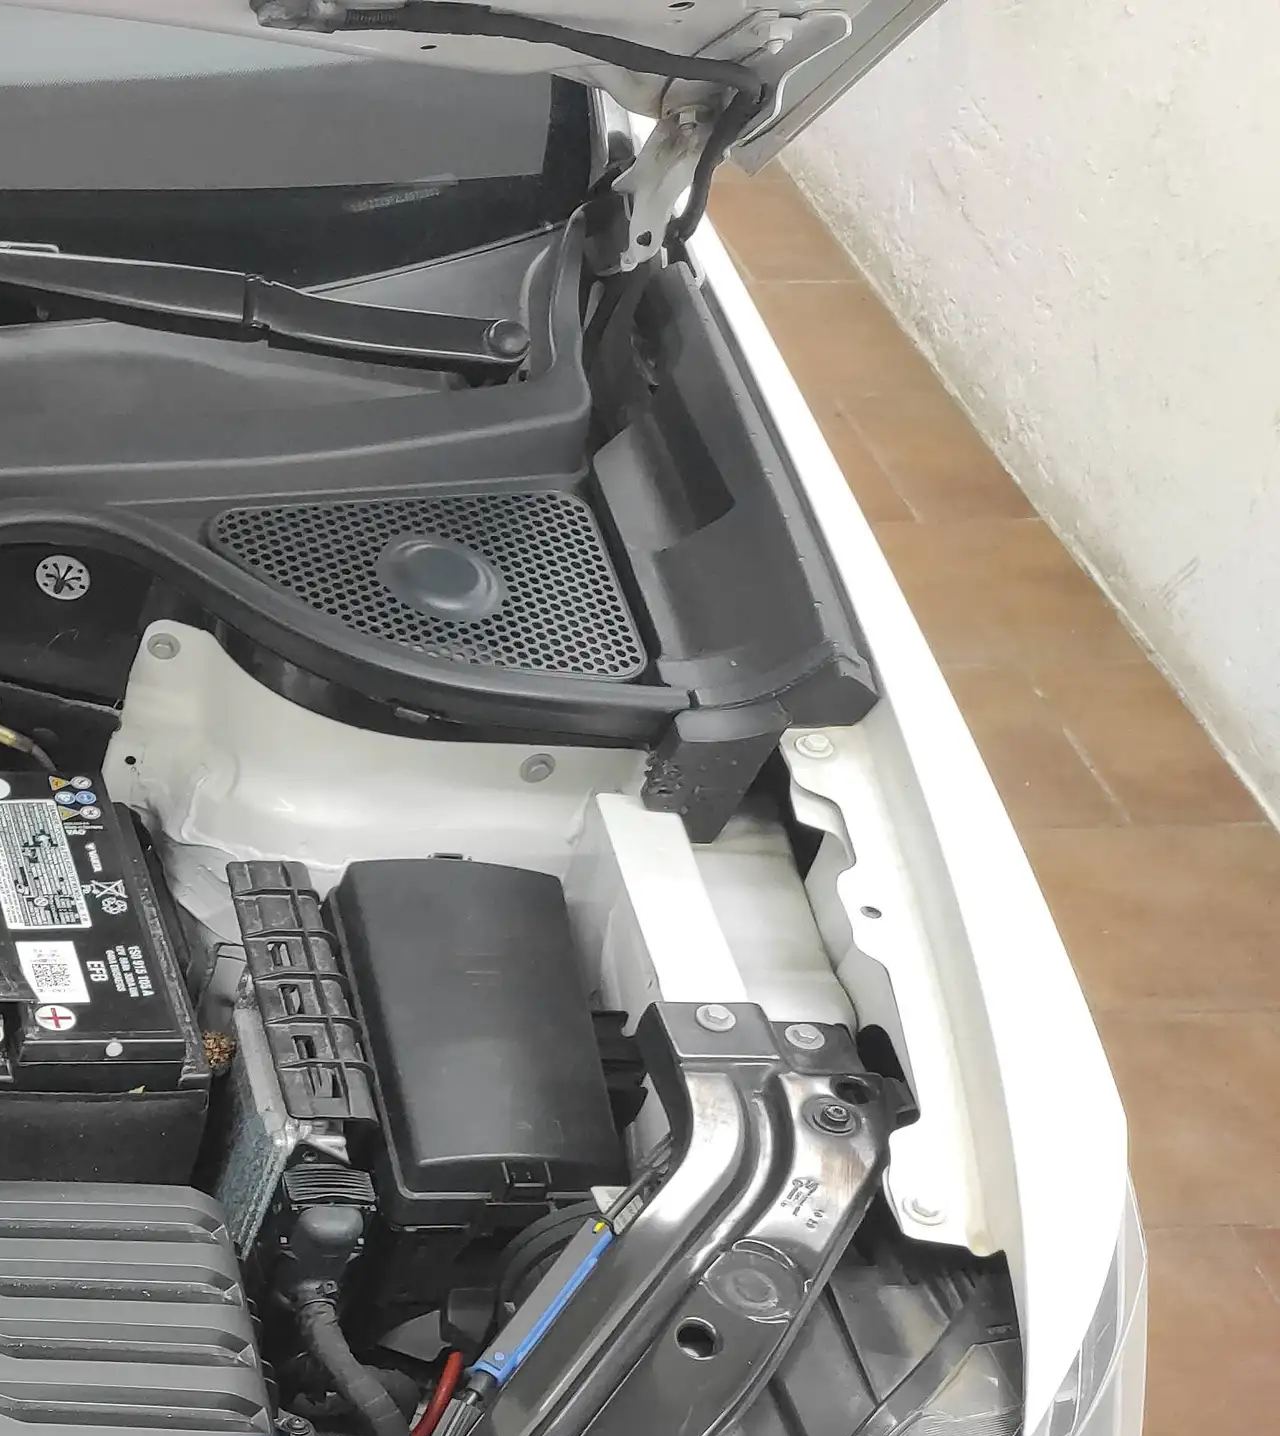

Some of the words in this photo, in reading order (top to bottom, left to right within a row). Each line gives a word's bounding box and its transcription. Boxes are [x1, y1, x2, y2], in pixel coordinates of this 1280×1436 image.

[88, 849, 103, 873] VARTA
[127, 945, 143, 960] 1S0
[86, 960, 109, 982] EFB
[132, 960, 148, 974] 915
[138, 975, 153, 990] 105
[141, 989, 156, 997] A
